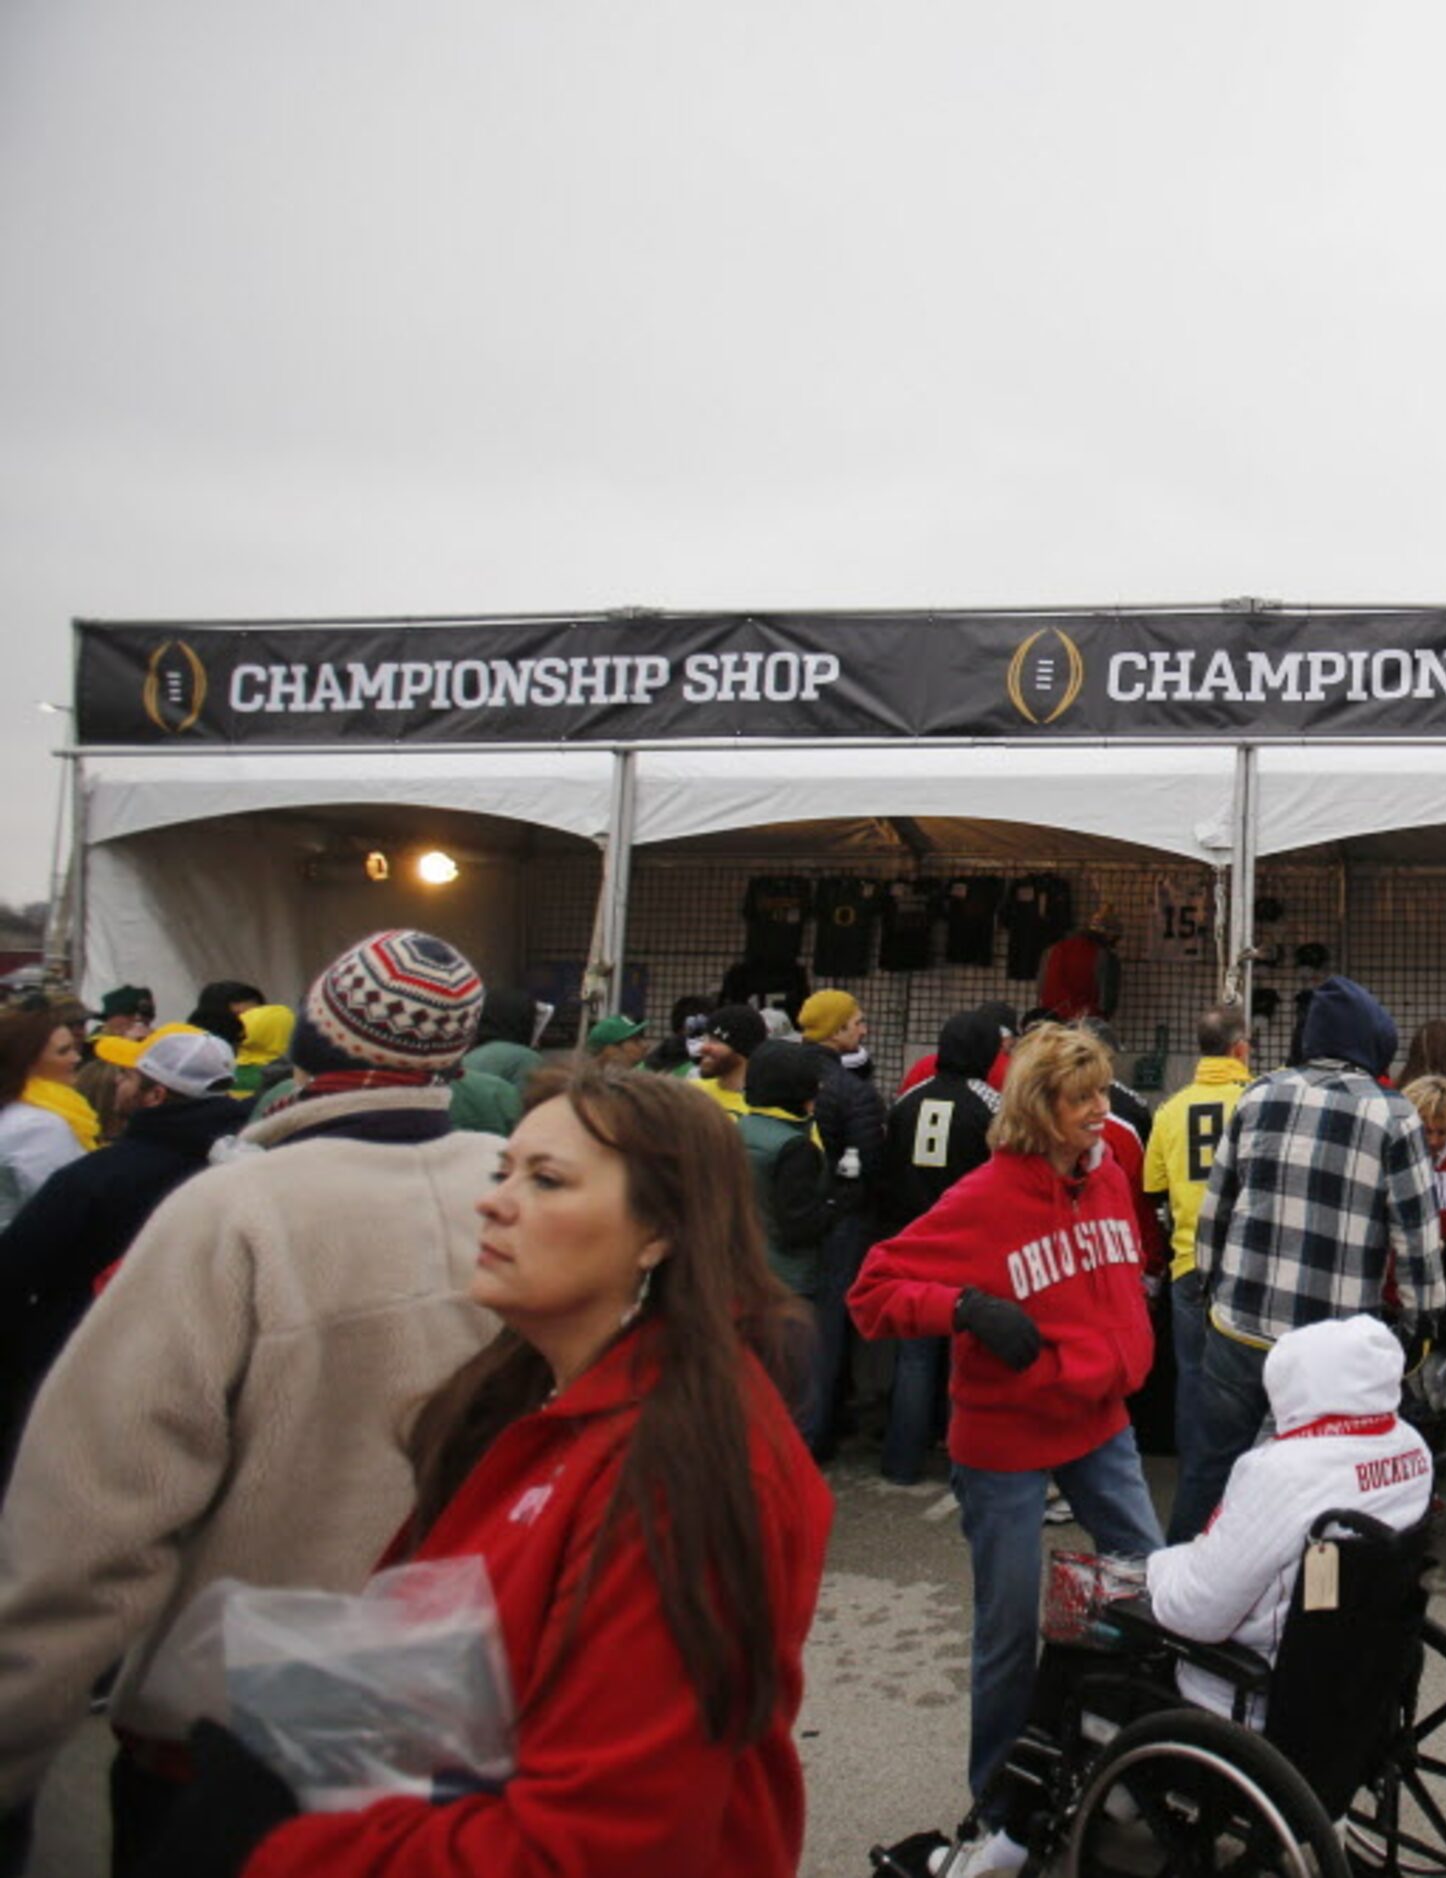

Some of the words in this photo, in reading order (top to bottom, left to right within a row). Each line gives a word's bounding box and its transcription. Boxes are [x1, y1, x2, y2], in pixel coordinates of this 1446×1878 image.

[230, 655, 669, 713] CHAMPIONSHIP
[684, 652, 840, 703] SHOP
[1163, 906, 1196, 939] 15
[912, 1100, 954, 1167] 8
[1007, 1229, 1077, 1300] OHIO
